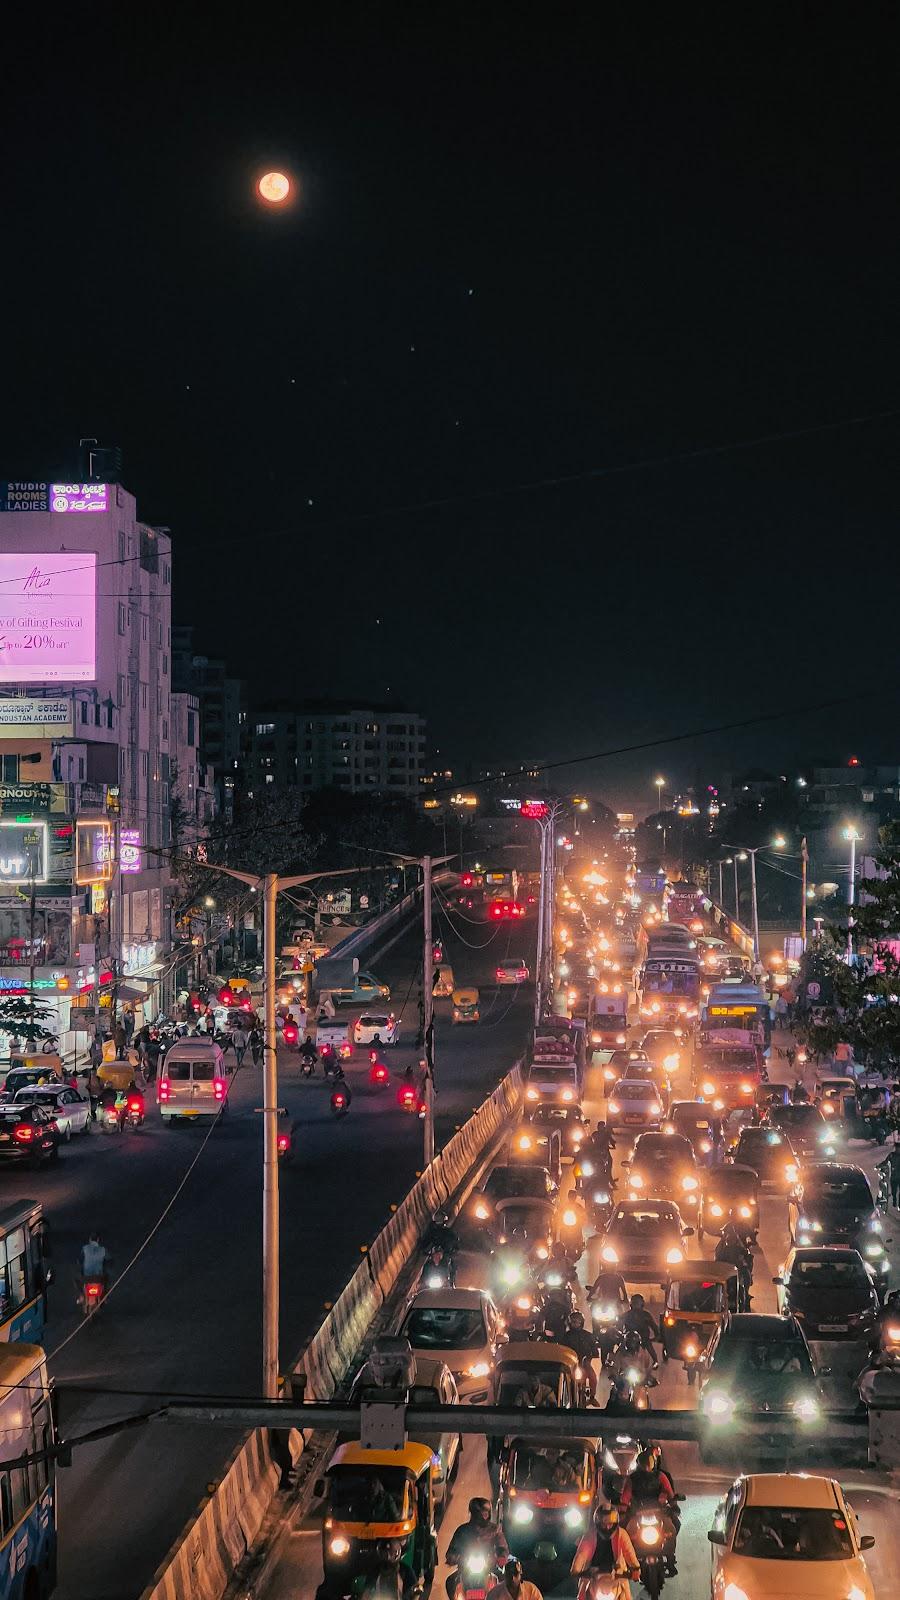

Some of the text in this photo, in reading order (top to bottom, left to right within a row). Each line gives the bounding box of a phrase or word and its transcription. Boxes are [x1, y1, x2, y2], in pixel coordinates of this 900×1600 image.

[7, 482, 47, 490] STUDIO
[7, 491, 47, 500] ROOMS
[7, 501, 47, 510] LADIES
[6, 617, 16, 627] of
[17, 617, 48, 629] Gifting
[49, 617, 83, 628] Festival
[23, 634, 55, 649] 20%
[33, 714, 67, 722] ACADEMY
[647, 962, 696, 973] GLIDE
